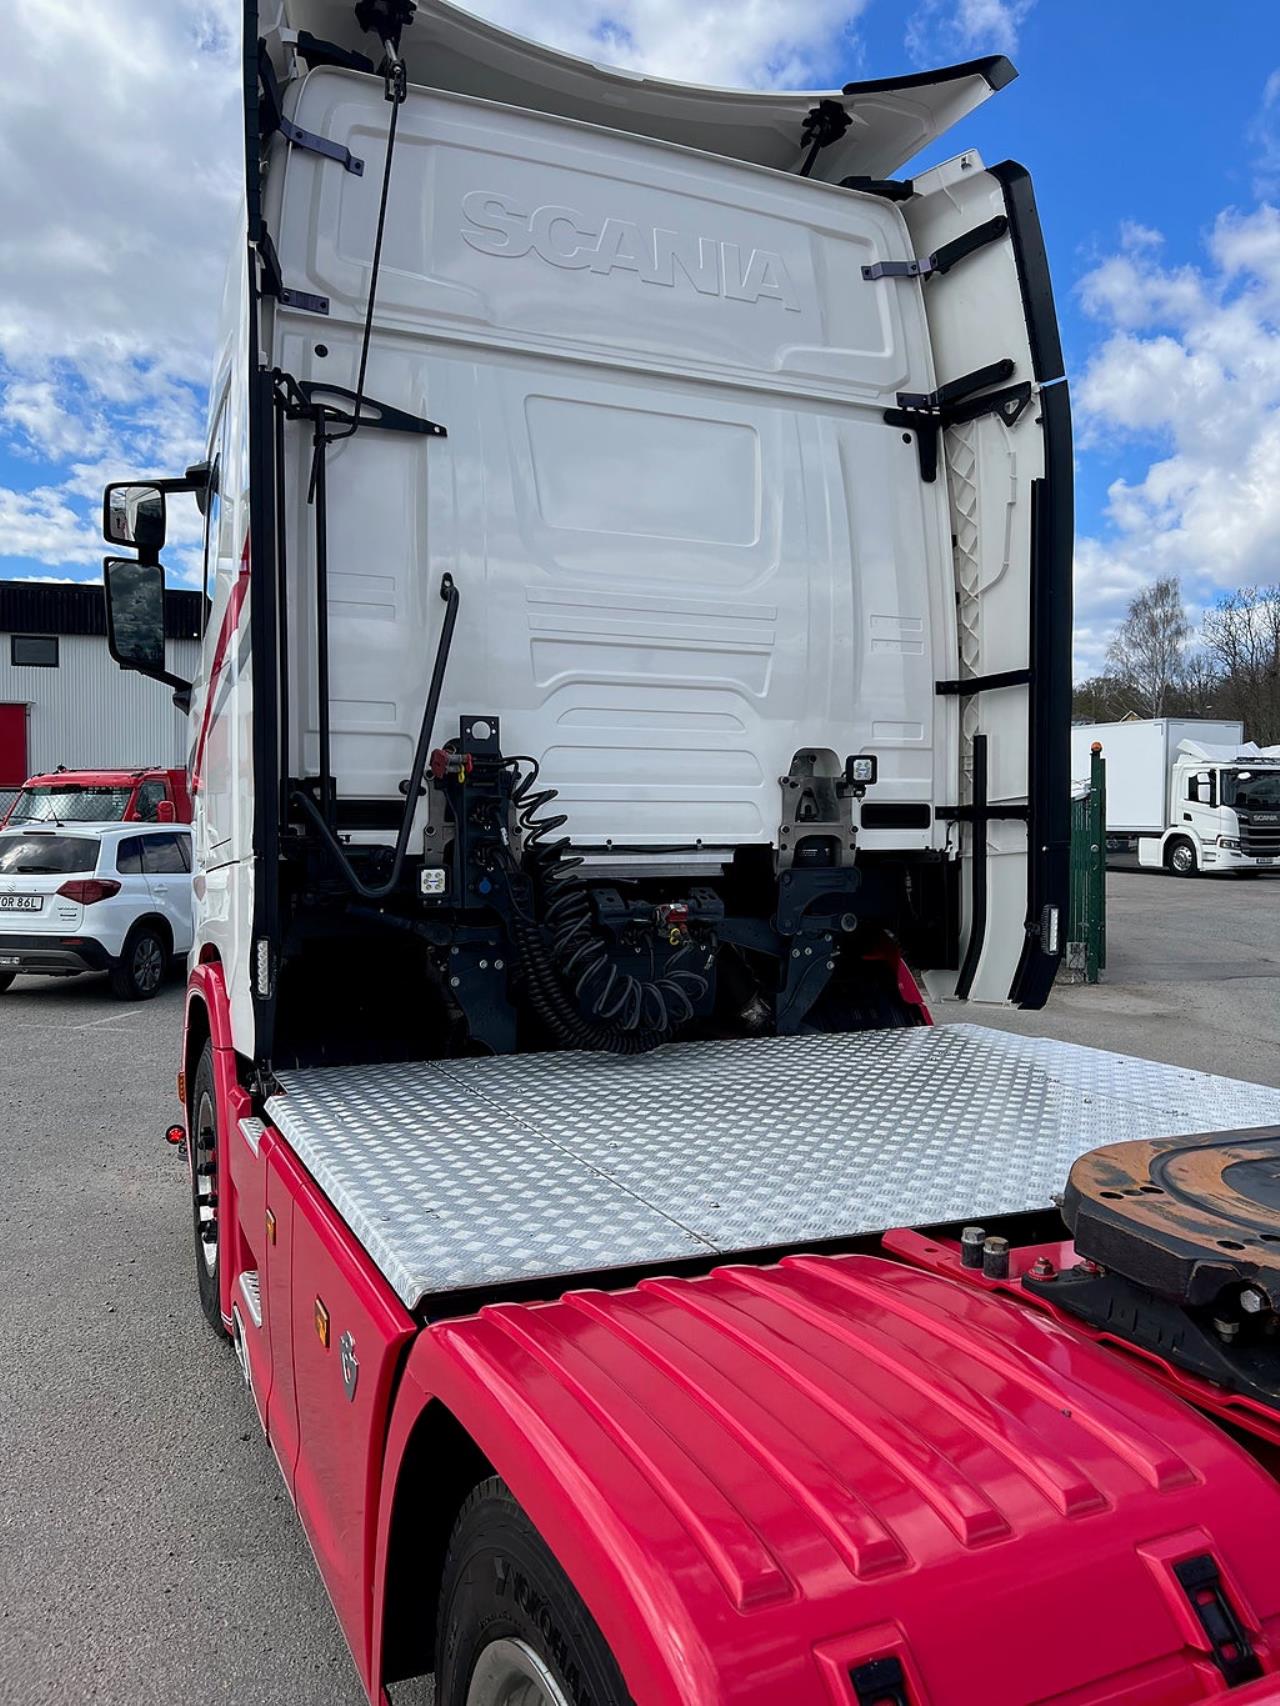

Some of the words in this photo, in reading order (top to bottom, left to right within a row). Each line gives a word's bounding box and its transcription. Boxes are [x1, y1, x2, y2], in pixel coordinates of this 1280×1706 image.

[460, 190, 801, 313] SCANIA
[0, 896, 15, 908] OR
[17, 896, 37, 908] 86L
